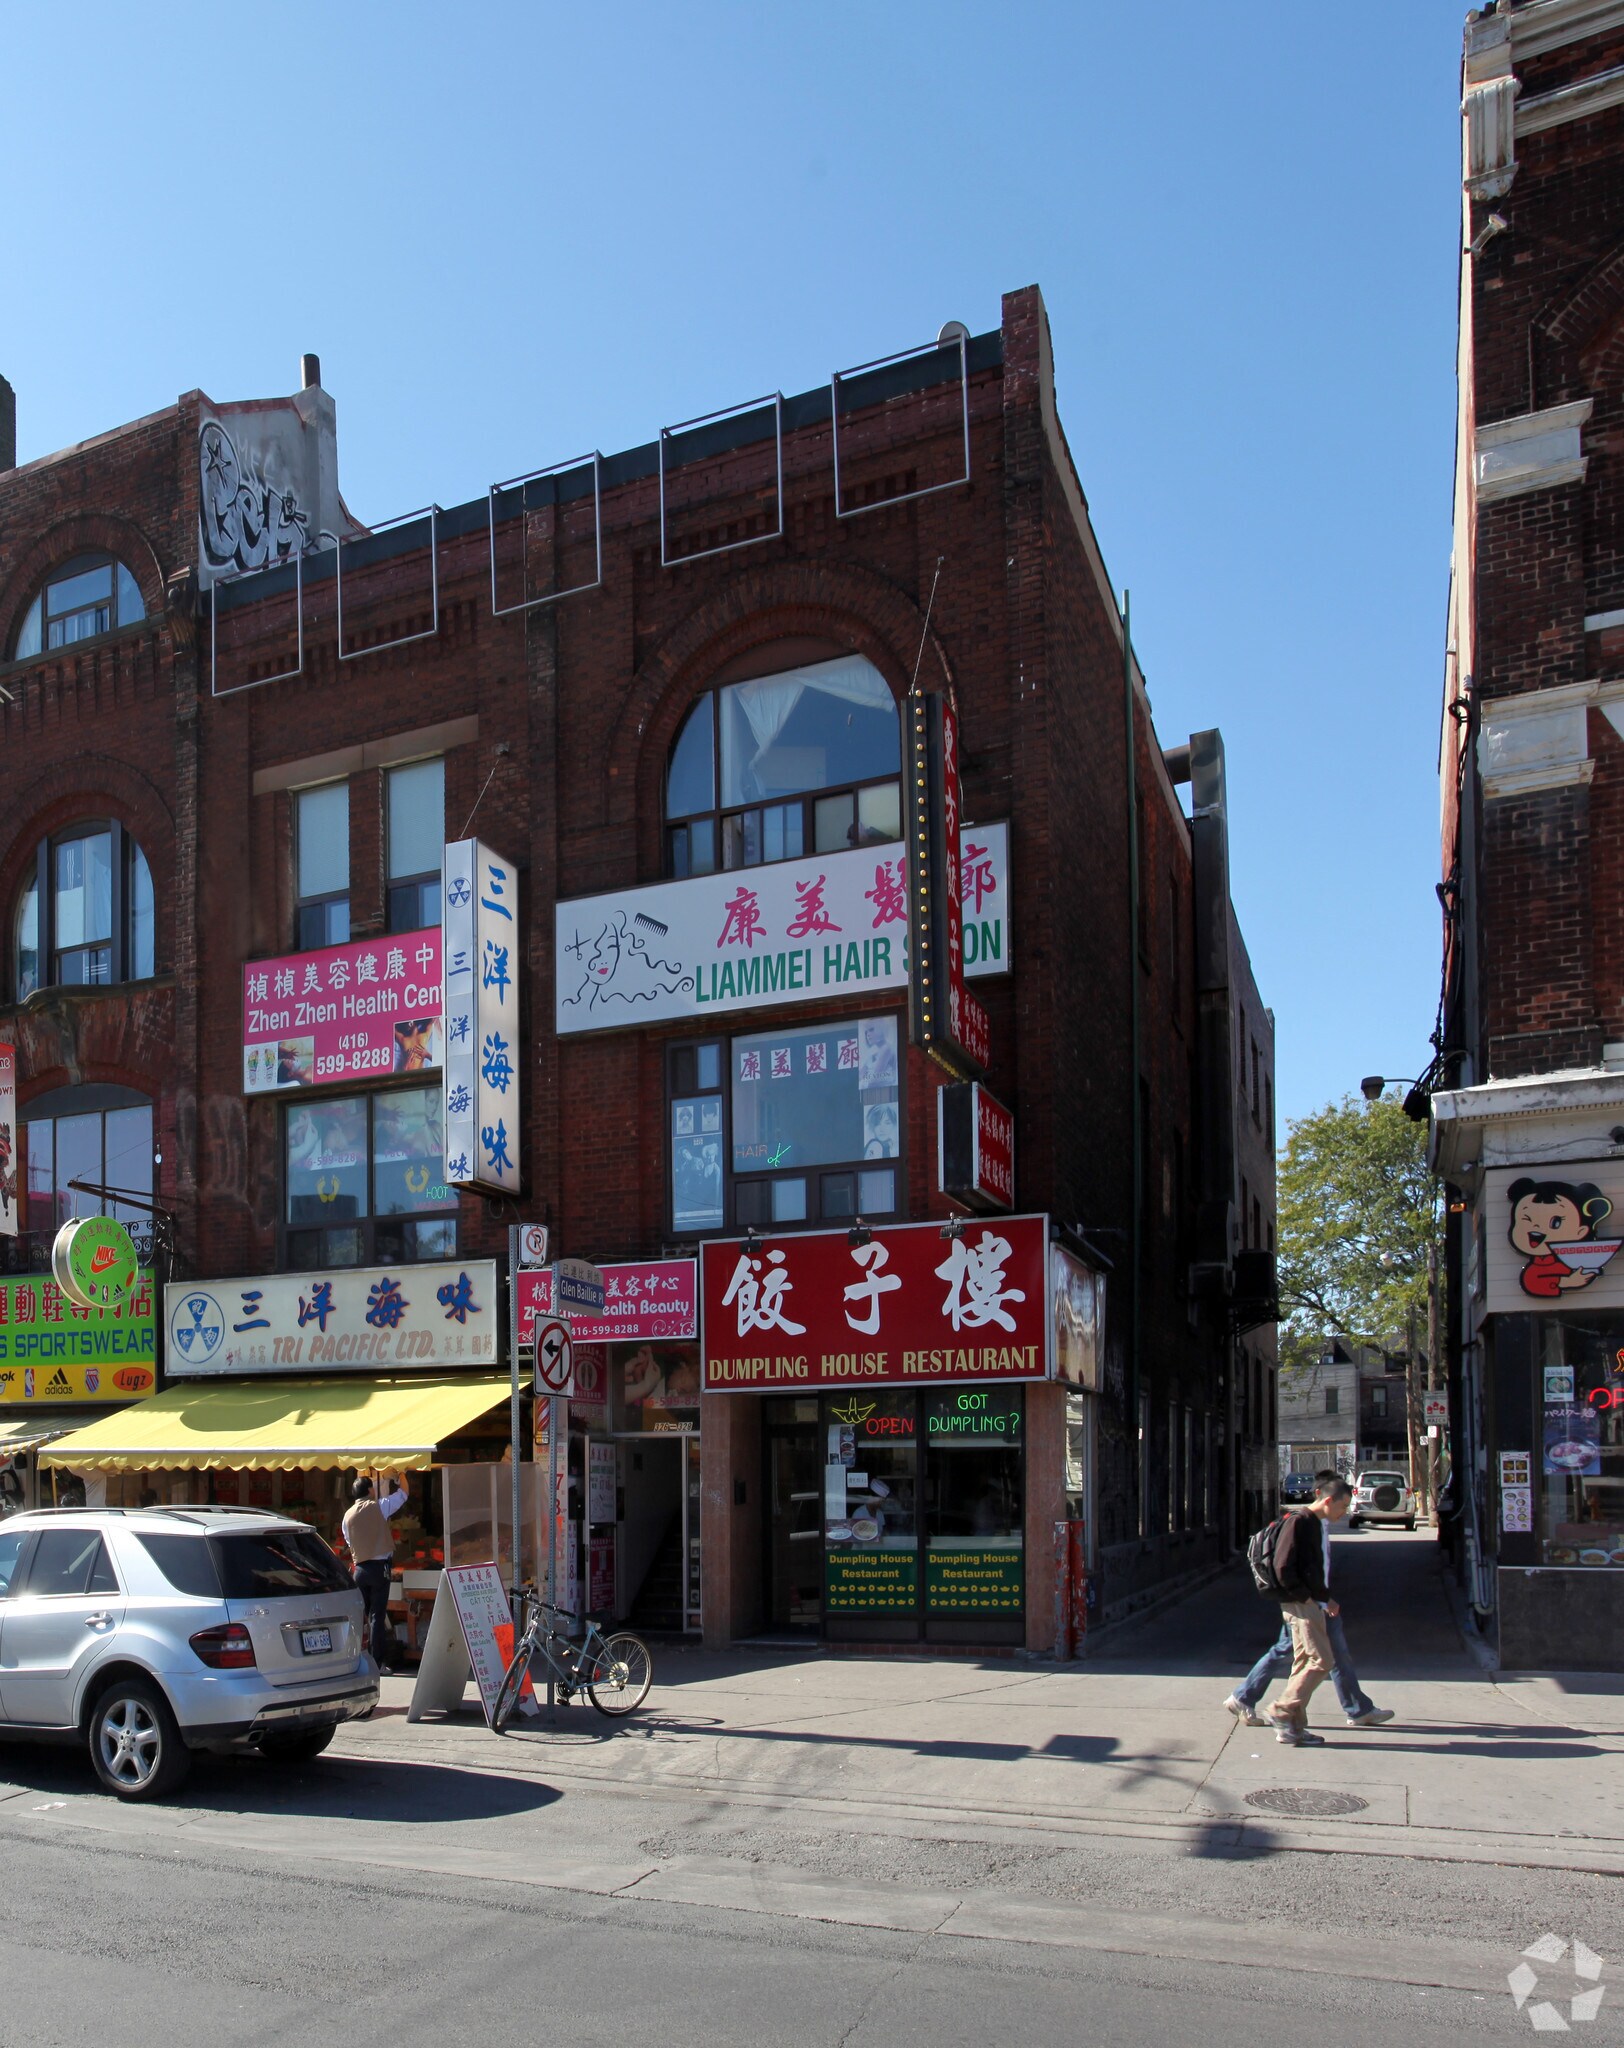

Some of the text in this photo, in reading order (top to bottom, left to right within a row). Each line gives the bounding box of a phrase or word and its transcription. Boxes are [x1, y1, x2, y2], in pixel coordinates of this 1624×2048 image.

[695, 949, 812, 1003] LIAMMEI
[823, 937, 891, 985] HAIR
[248, 982, 443, 1033] Zhen Zhen Health Cen
[481, 864, 514, 1176] 三洋海味
[338, 1032, 369, 1051] (416)
[317, 1047, 390, 1076] 599-8288
[447, 951, 472, 1180] 三洋海味
[736, 1144, 767, 1159] HAIR
[96, 1245, 116, 1262] NIKE
[561, 1280, 576, 1299] Glen
[577, 1283, 597, 1303] Baillie
[722, 1230, 1027, 1338] 餃子樓
[233, 1272, 481, 1334] 三洋海味
[602, 1301, 637, 1317] ealth
[640, 1299, 689, 1317] Beauty
[571, 1323, 640, 1337] 416-599-8288
[15, 1327, 154, 1359] SPORTSWEAR
[272, 1329, 437, 1364] TRI PACIFIC LTD.
[709, 1345, 1039, 1382] DUMPLING HOUSE RESTAURANT
[45, 1384, 73, 1395] adidas
[120, 1371, 148, 1391] Lugz
[957, 1394, 989, 1410] GOT
[866, 1417, 914, 1435] OPEN
[929, 1415, 1005, 1433] DUMPLING
[829, 1554, 914, 1566] Dumpling House
[929, 1553, 1018, 1566] Dumpling House
[842, 1569, 899, 1579] Restaurant
[942, 1568, 1004, 1579] Restaurant
